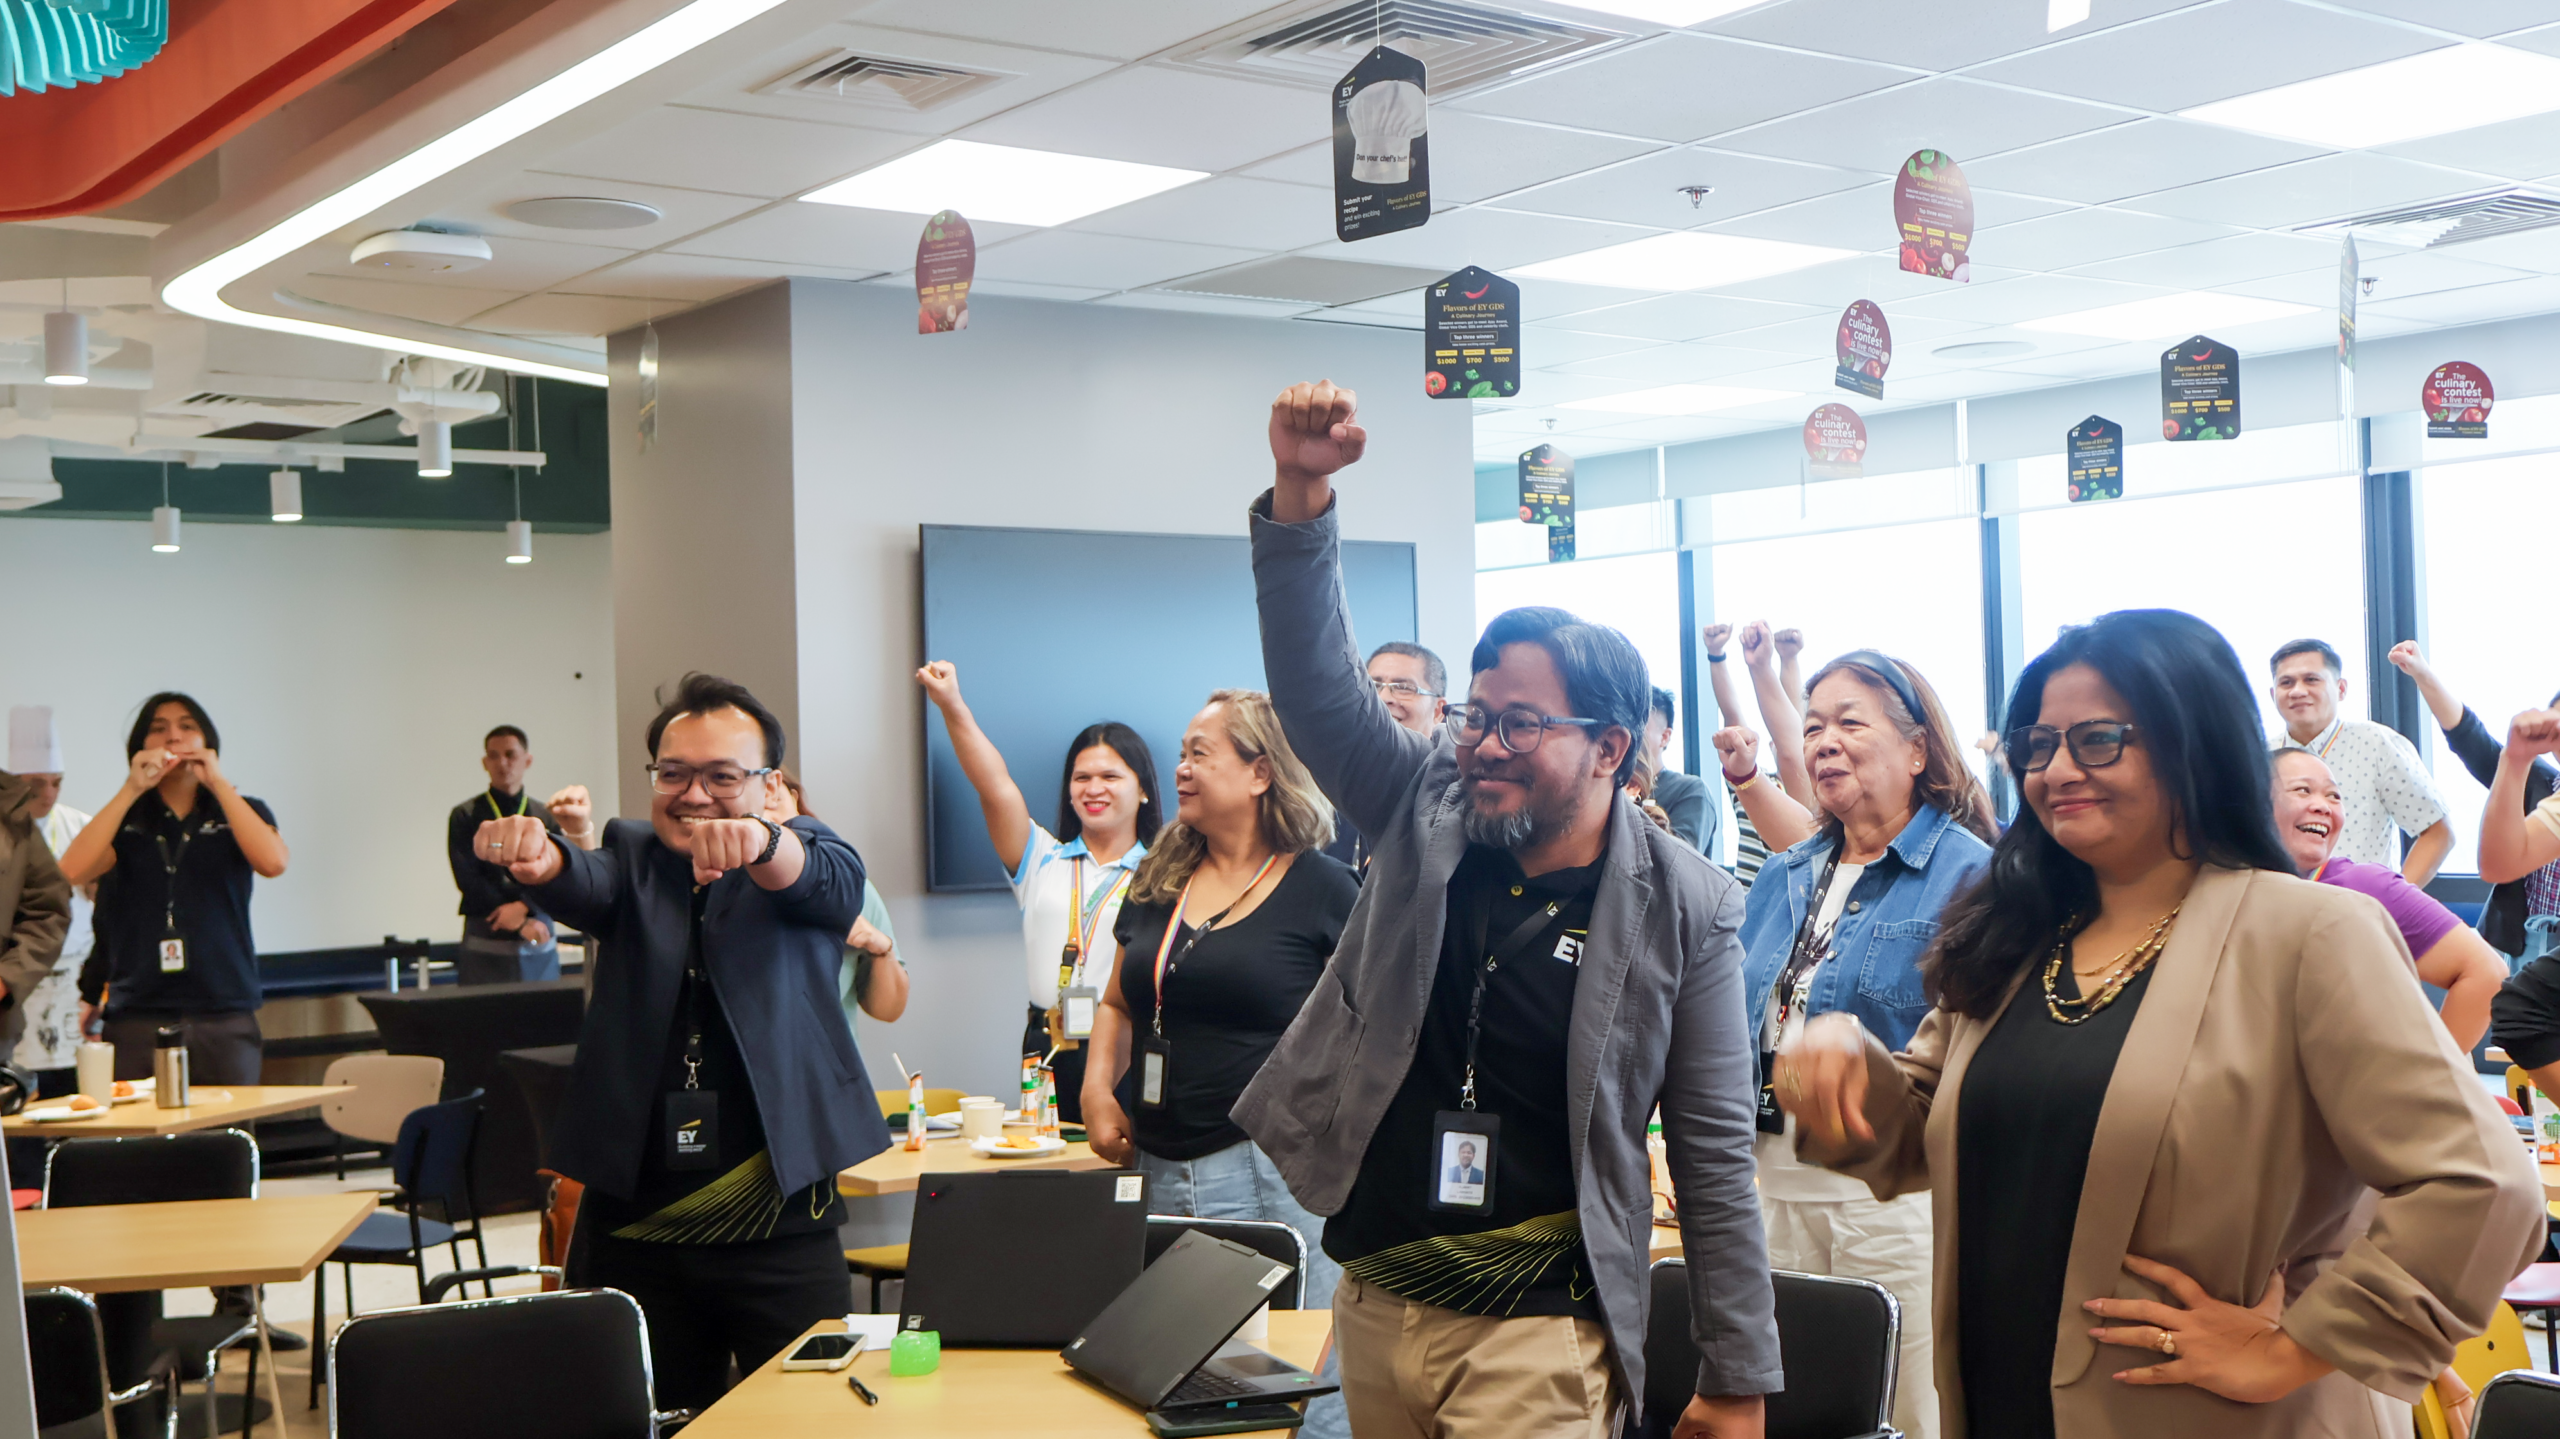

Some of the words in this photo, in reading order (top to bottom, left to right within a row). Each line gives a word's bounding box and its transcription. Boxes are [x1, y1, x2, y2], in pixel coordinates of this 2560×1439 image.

[1342, 85, 1353, 97] EY
[1344, 196, 1360, 206] Submit
[1361, 195, 1373, 203] your
[1344, 206, 1358, 214] recipe
[1363, 210, 1380, 218] exciting
[1436, 289, 1447, 297] EY
[1863, 313, 1872, 324] The
[1848, 318, 1879, 337] culinary
[1854, 330, 1882, 348] contest
[1851, 338, 1856, 347] is
[1857, 340, 1867, 352] live
[2435, 378, 2476, 389] culinary
[2444, 388, 2482, 396] contest
[1815, 419, 1850, 430] culinary
[1823, 429, 1856, 438] contest
[1547, 906, 1558, 917] EY
[1487, 961, 1498, 972] EY
[678, 1130, 697, 1144] EY
